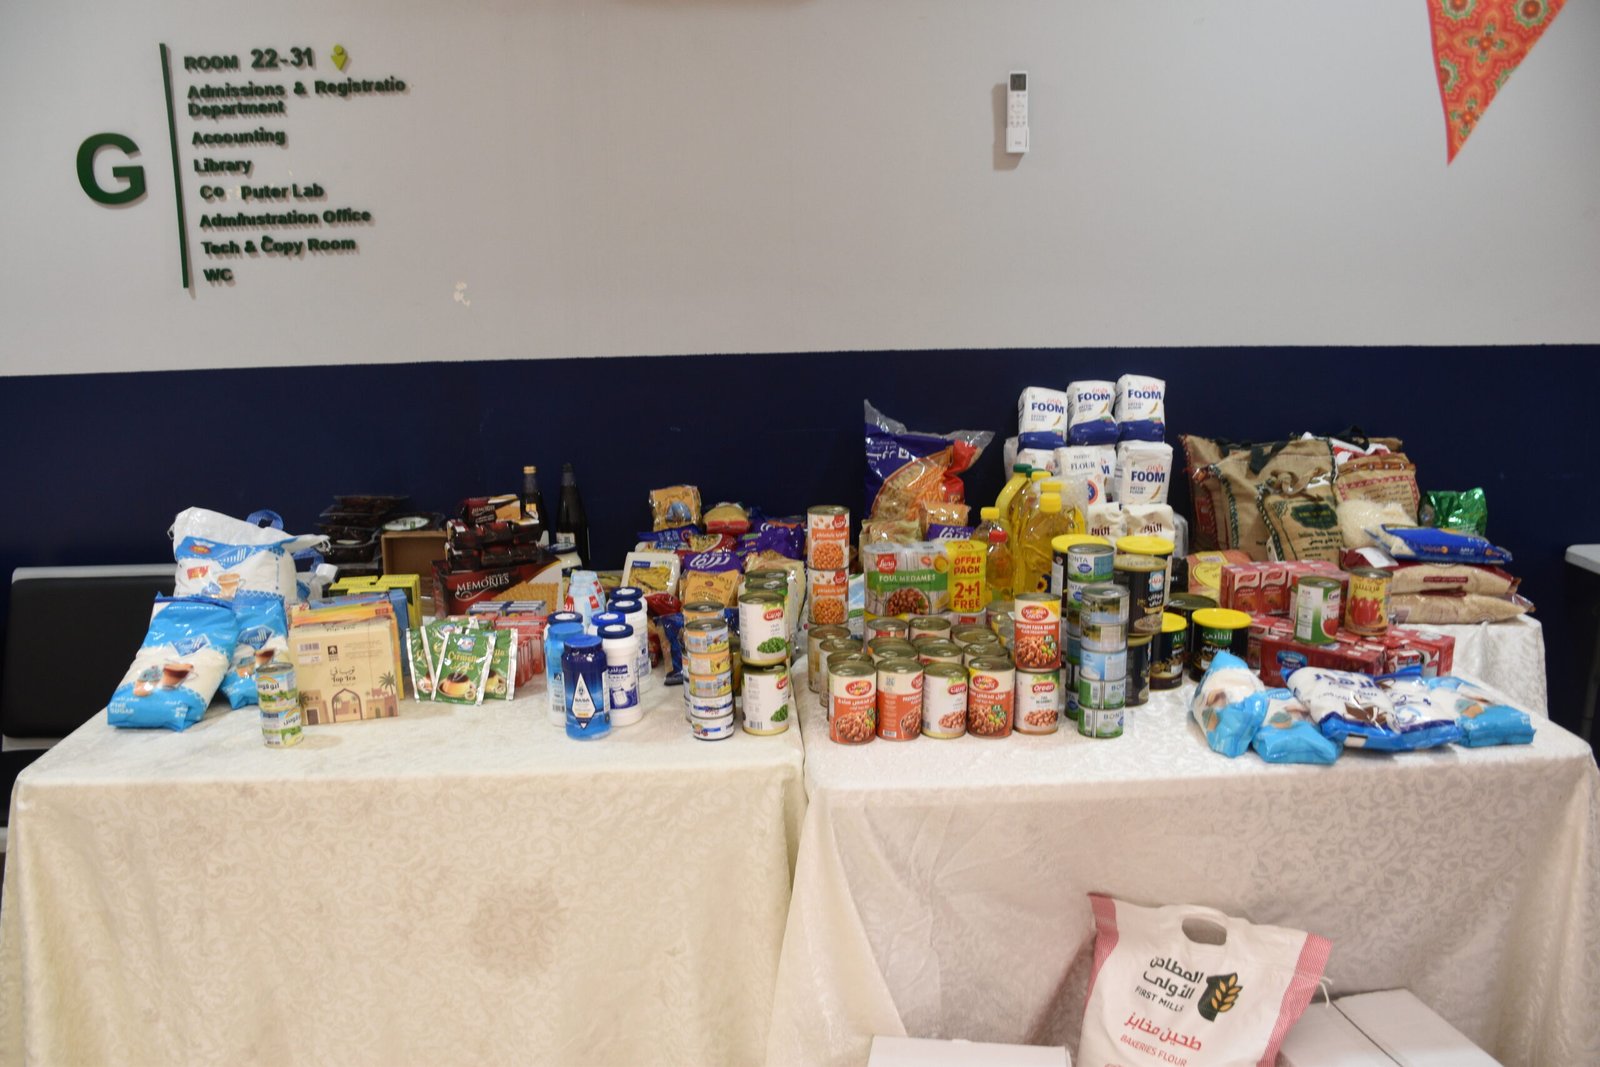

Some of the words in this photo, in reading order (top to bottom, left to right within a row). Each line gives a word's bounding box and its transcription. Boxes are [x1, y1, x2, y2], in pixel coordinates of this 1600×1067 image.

[183, 55, 239, 71] ROOM
[250, 47, 314, 69] 22-31
[187, 80, 286, 100] Admissions
[293, 81, 307, 95] &
[314, 76, 407, 98] Registratio
[188, 100, 286, 119] Department
[192, 126, 286, 146] Accounting
[76, 132, 146, 205] G
[193, 157, 252, 175] Library
[292, 183, 325, 199] Lab
[322, 207, 372, 224] Office
[202, 240, 241, 255] Tech
[244, 240, 258, 253] &
[260, 235, 304, 256] Copy
[307, 238, 357, 252] Room
[203, 268, 234, 282] WC
[1077, 392, 1111, 403] FOOM
[1127, 389, 1162, 401] FOOM
[1031, 402, 1065, 415] FOOM
[1070, 461, 1096, 470] FLOUR
[1130, 471, 1166, 483] FOOM
[954, 555, 982, 565] OFFER
[953, 565, 981, 576] PACK
[457, 575, 510, 592] MEMORIES
[954, 580, 982, 600] 2+1
[953, 598, 981, 609] FREE
[1150, 956, 1204, 984] المطاحن
[1135, 985, 1158, 1001] FIRST
[1124, 1012, 1160, 1035] مخابز
[1159, 1028, 1202, 1051] طحين
[1120, 1033, 1157, 1056] BAKERIES
[1157, 1049, 1188, 1067] FLOUR
